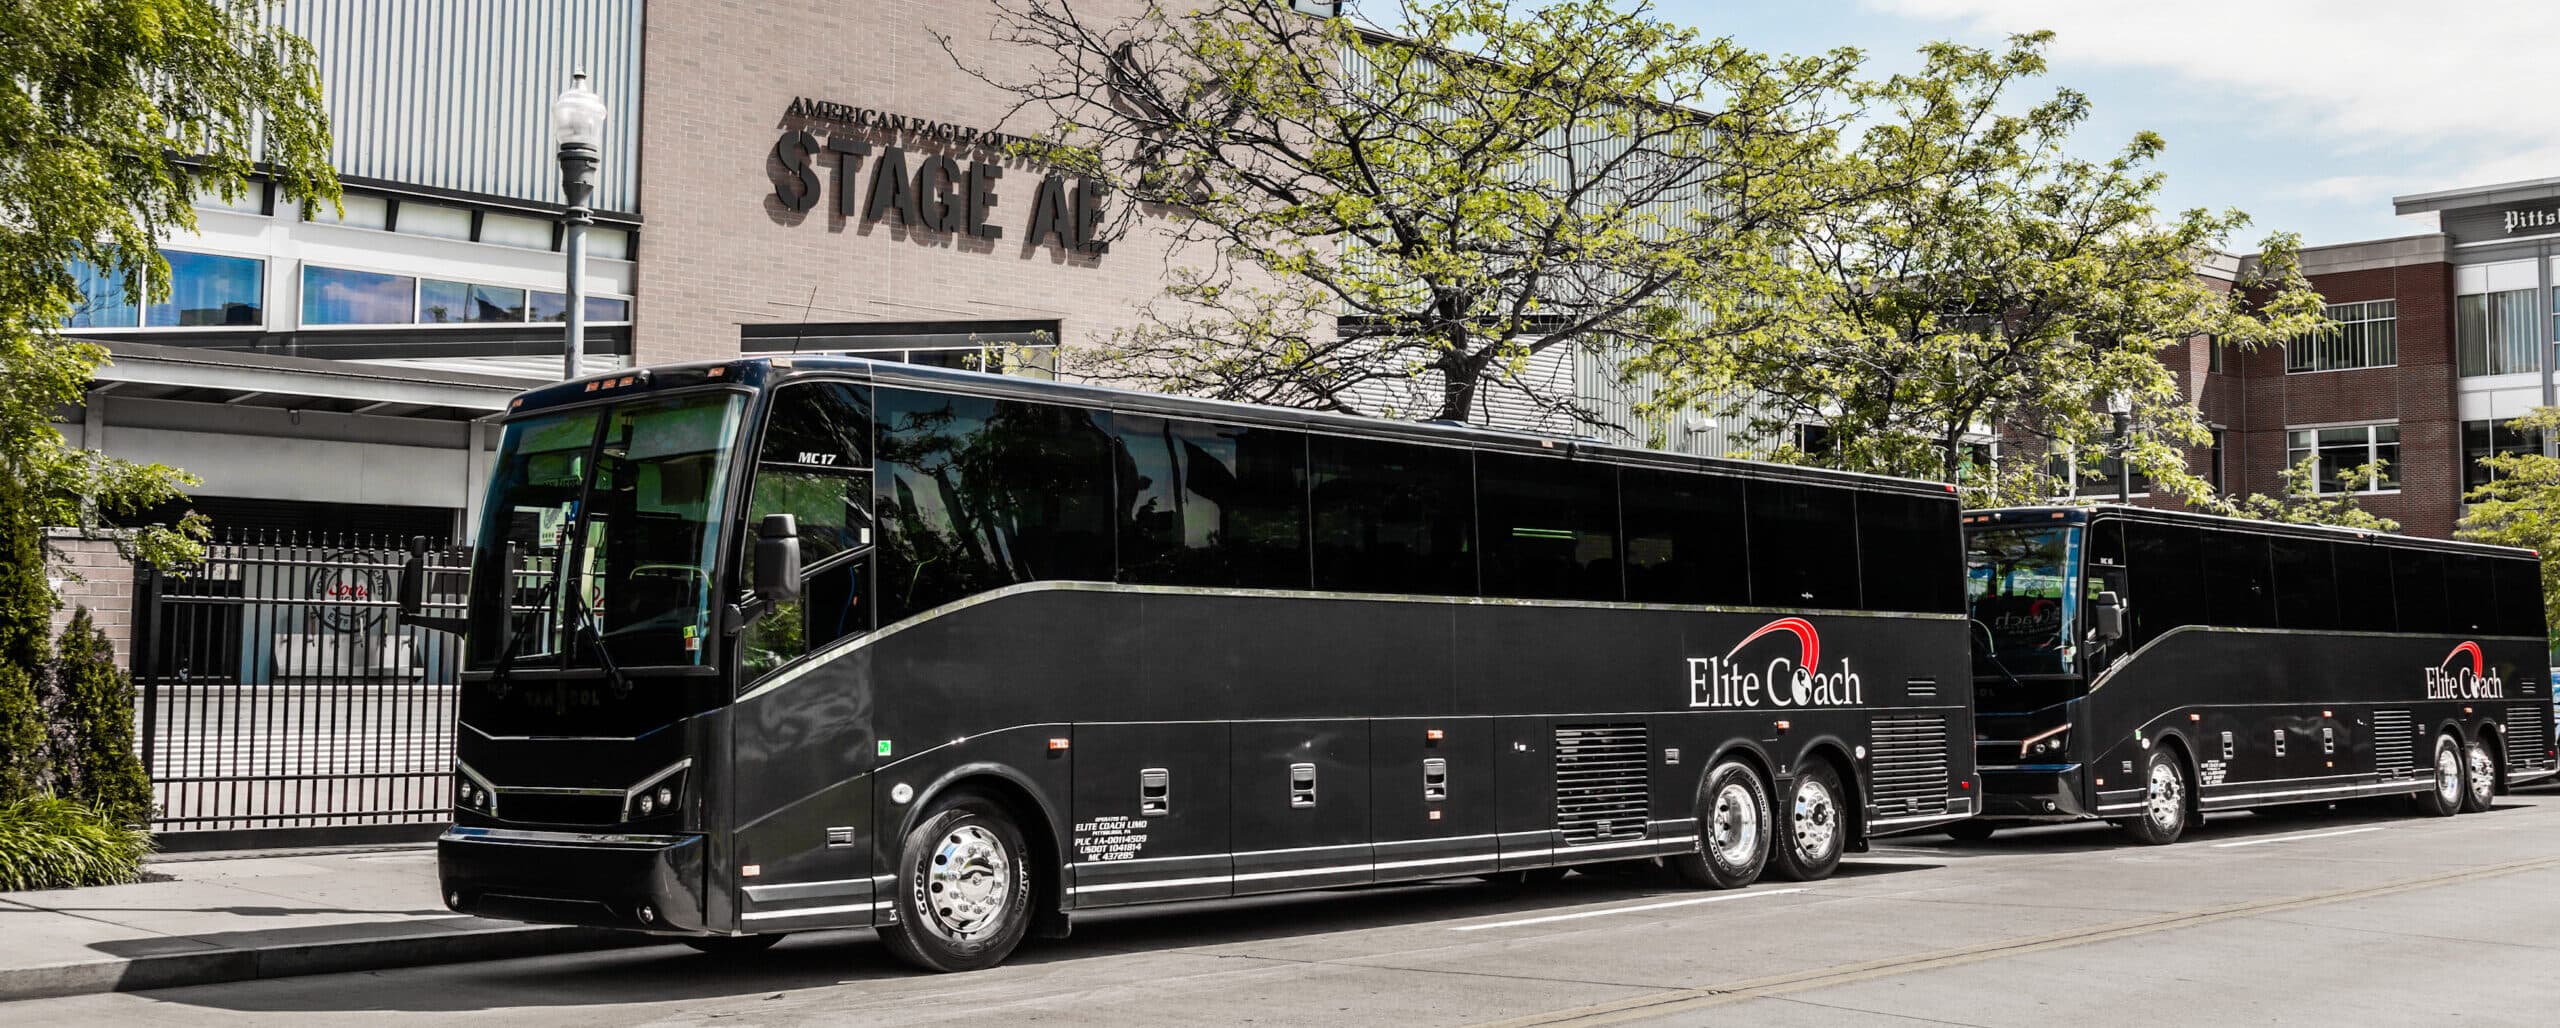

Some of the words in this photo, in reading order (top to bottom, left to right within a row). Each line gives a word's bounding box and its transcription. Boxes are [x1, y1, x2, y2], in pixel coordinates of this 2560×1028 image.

[790, 95, 908, 132] AMERICAN
[911, 117, 978, 144] EAGLE
[777, 130, 1003, 239] STAGE
[1029, 172, 1110, 254] AE
[1687, 656, 1759, 707] Elite
[1766, 657, 1863, 706] Coach
[2425, 666, 2458, 699] Elite
[2460, 666, 2503, 699] Coach
[1075, 823, 1097, 831] ELITE
[1099, 821, 1126, 830] COACH
[1127, 820, 1147, 829] LIMO
[1080, 845, 1108, 854] USDOT
[1088, 853, 1101, 861] MC
